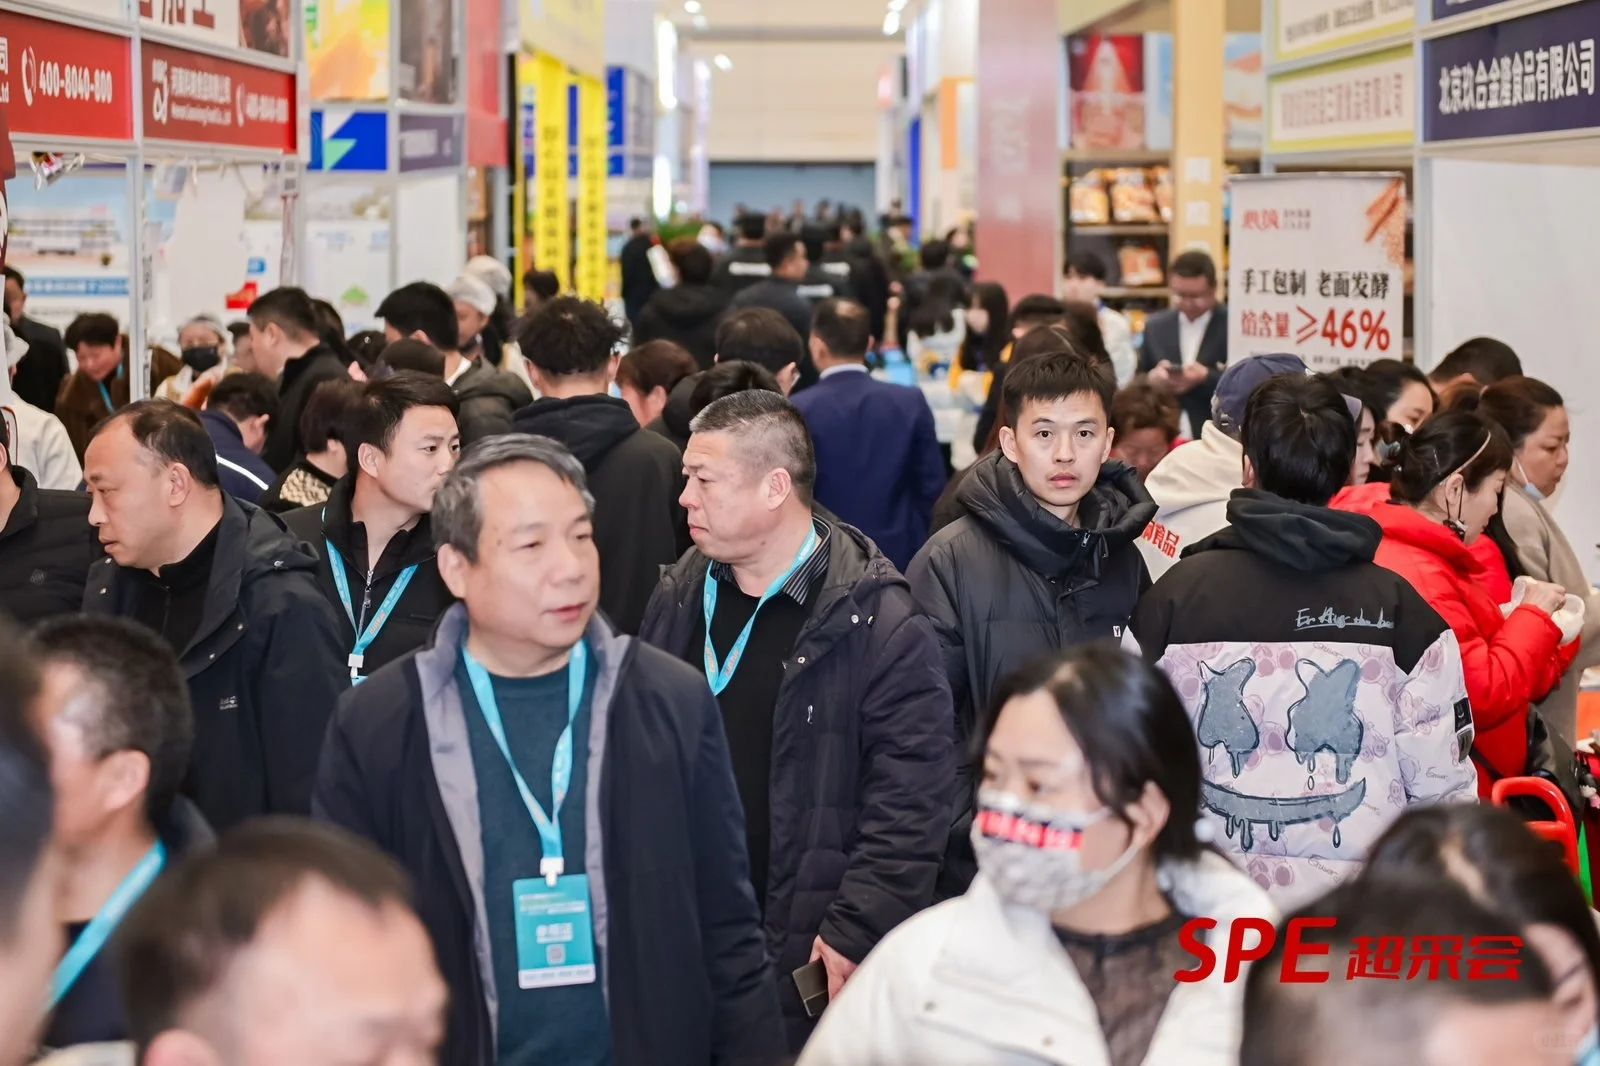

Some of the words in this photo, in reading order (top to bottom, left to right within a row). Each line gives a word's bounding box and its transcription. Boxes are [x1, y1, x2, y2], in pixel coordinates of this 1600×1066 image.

[39, 60, 113, 104] 400-8040-800
[1242, 268, 1308, 297] 手工包制
[1317, 269, 1391, 302] 老面发酵
